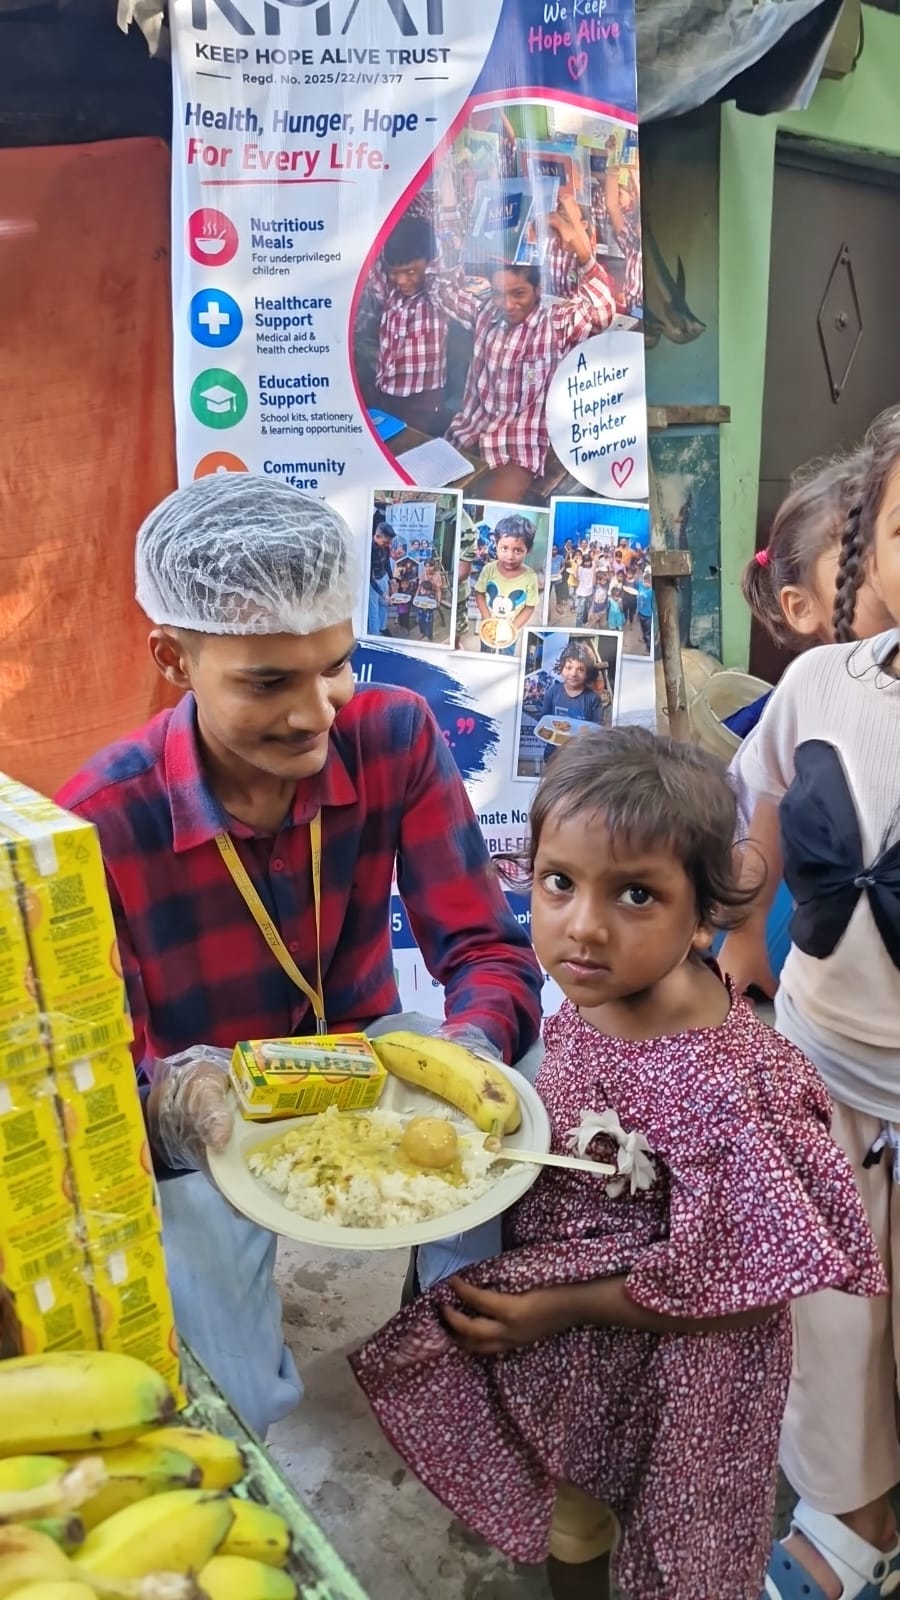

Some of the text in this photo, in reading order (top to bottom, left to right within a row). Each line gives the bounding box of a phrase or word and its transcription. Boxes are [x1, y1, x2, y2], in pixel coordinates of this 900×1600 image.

[544, 0, 607, 23] We Keep
[528, 18, 620, 54] Hope Alive
[196, 42, 450, 65] KEEP HOPE ALIVE TRUST
[243, 73, 277, 85] Regd.
[281, 74, 301, 85] No.
[185, 102, 264, 136] Health,
[273, 111, 355, 137] Hunger,
[363, 109, 418, 137] Hope
[187, 137, 391, 177] For Every Life.
[251, 218, 325, 233] Nutritious
[252, 235, 294, 249] Meals
[252, 252, 342, 265] For underprivileged
[252, 267, 290, 276] children
[255, 296, 333, 311] Healthcare
[255, 313, 314, 330] Support
[256, 332, 316, 343] Medical aid &
[256, 344, 330, 355] health checkups
[577, 352, 588, 373] A
[258, 374, 330, 389] Education
[567, 366, 629, 398] Healthier
[259, 392, 317, 410] Support
[573, 391, 624, 420] Happier
[260, 411, 354, 423] School kits, stationery
[261, 424, 363, 437] & learning opportunities
[571, 414, 626, 444] Brighter
[569, 435, 637, 467] Tomorrow
[263, 459, 346, 476] Community
[391, 913, 403, 932] 5
